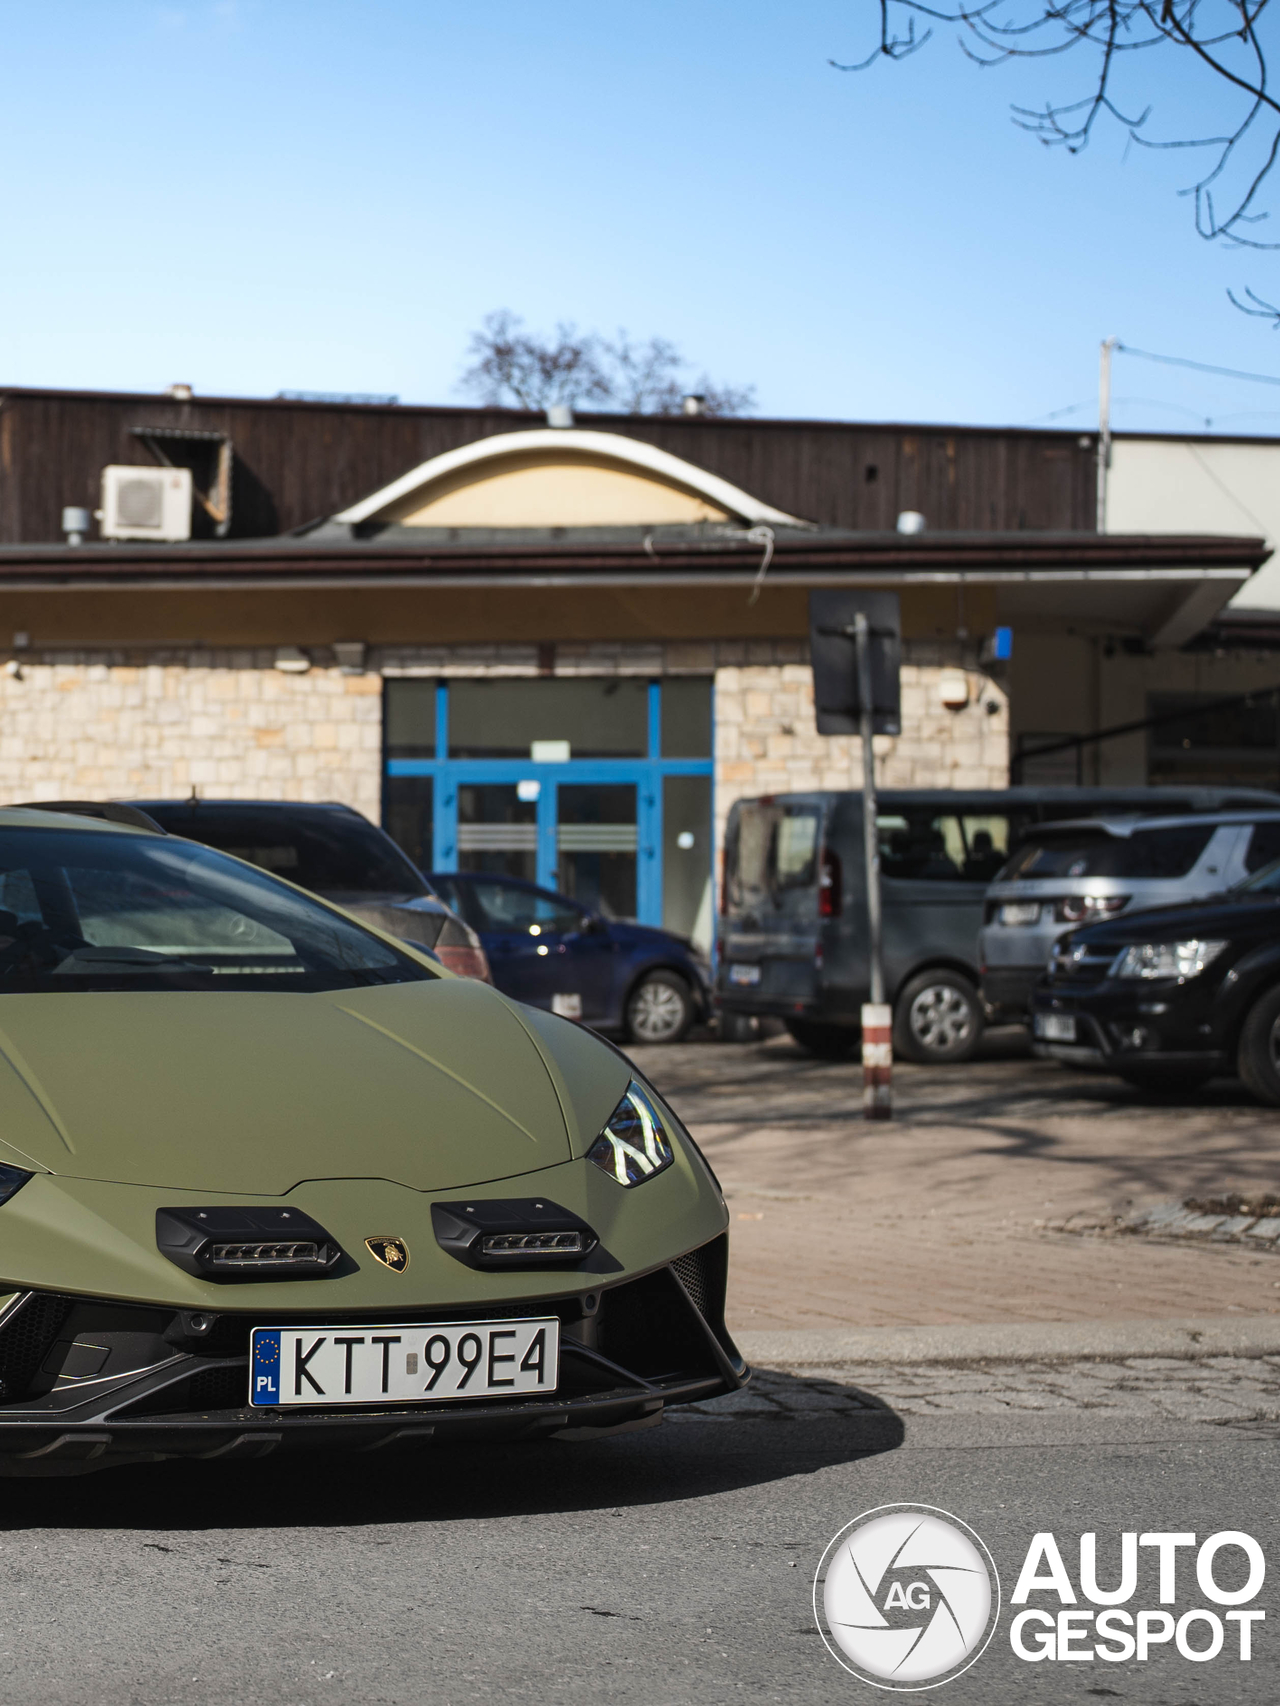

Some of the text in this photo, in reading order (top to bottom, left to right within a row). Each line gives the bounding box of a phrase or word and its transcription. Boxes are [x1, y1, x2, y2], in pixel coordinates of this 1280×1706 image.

[294, 1327, 546, 1395] KTT 99E4
[257, 1377, 276, 1392] PL
